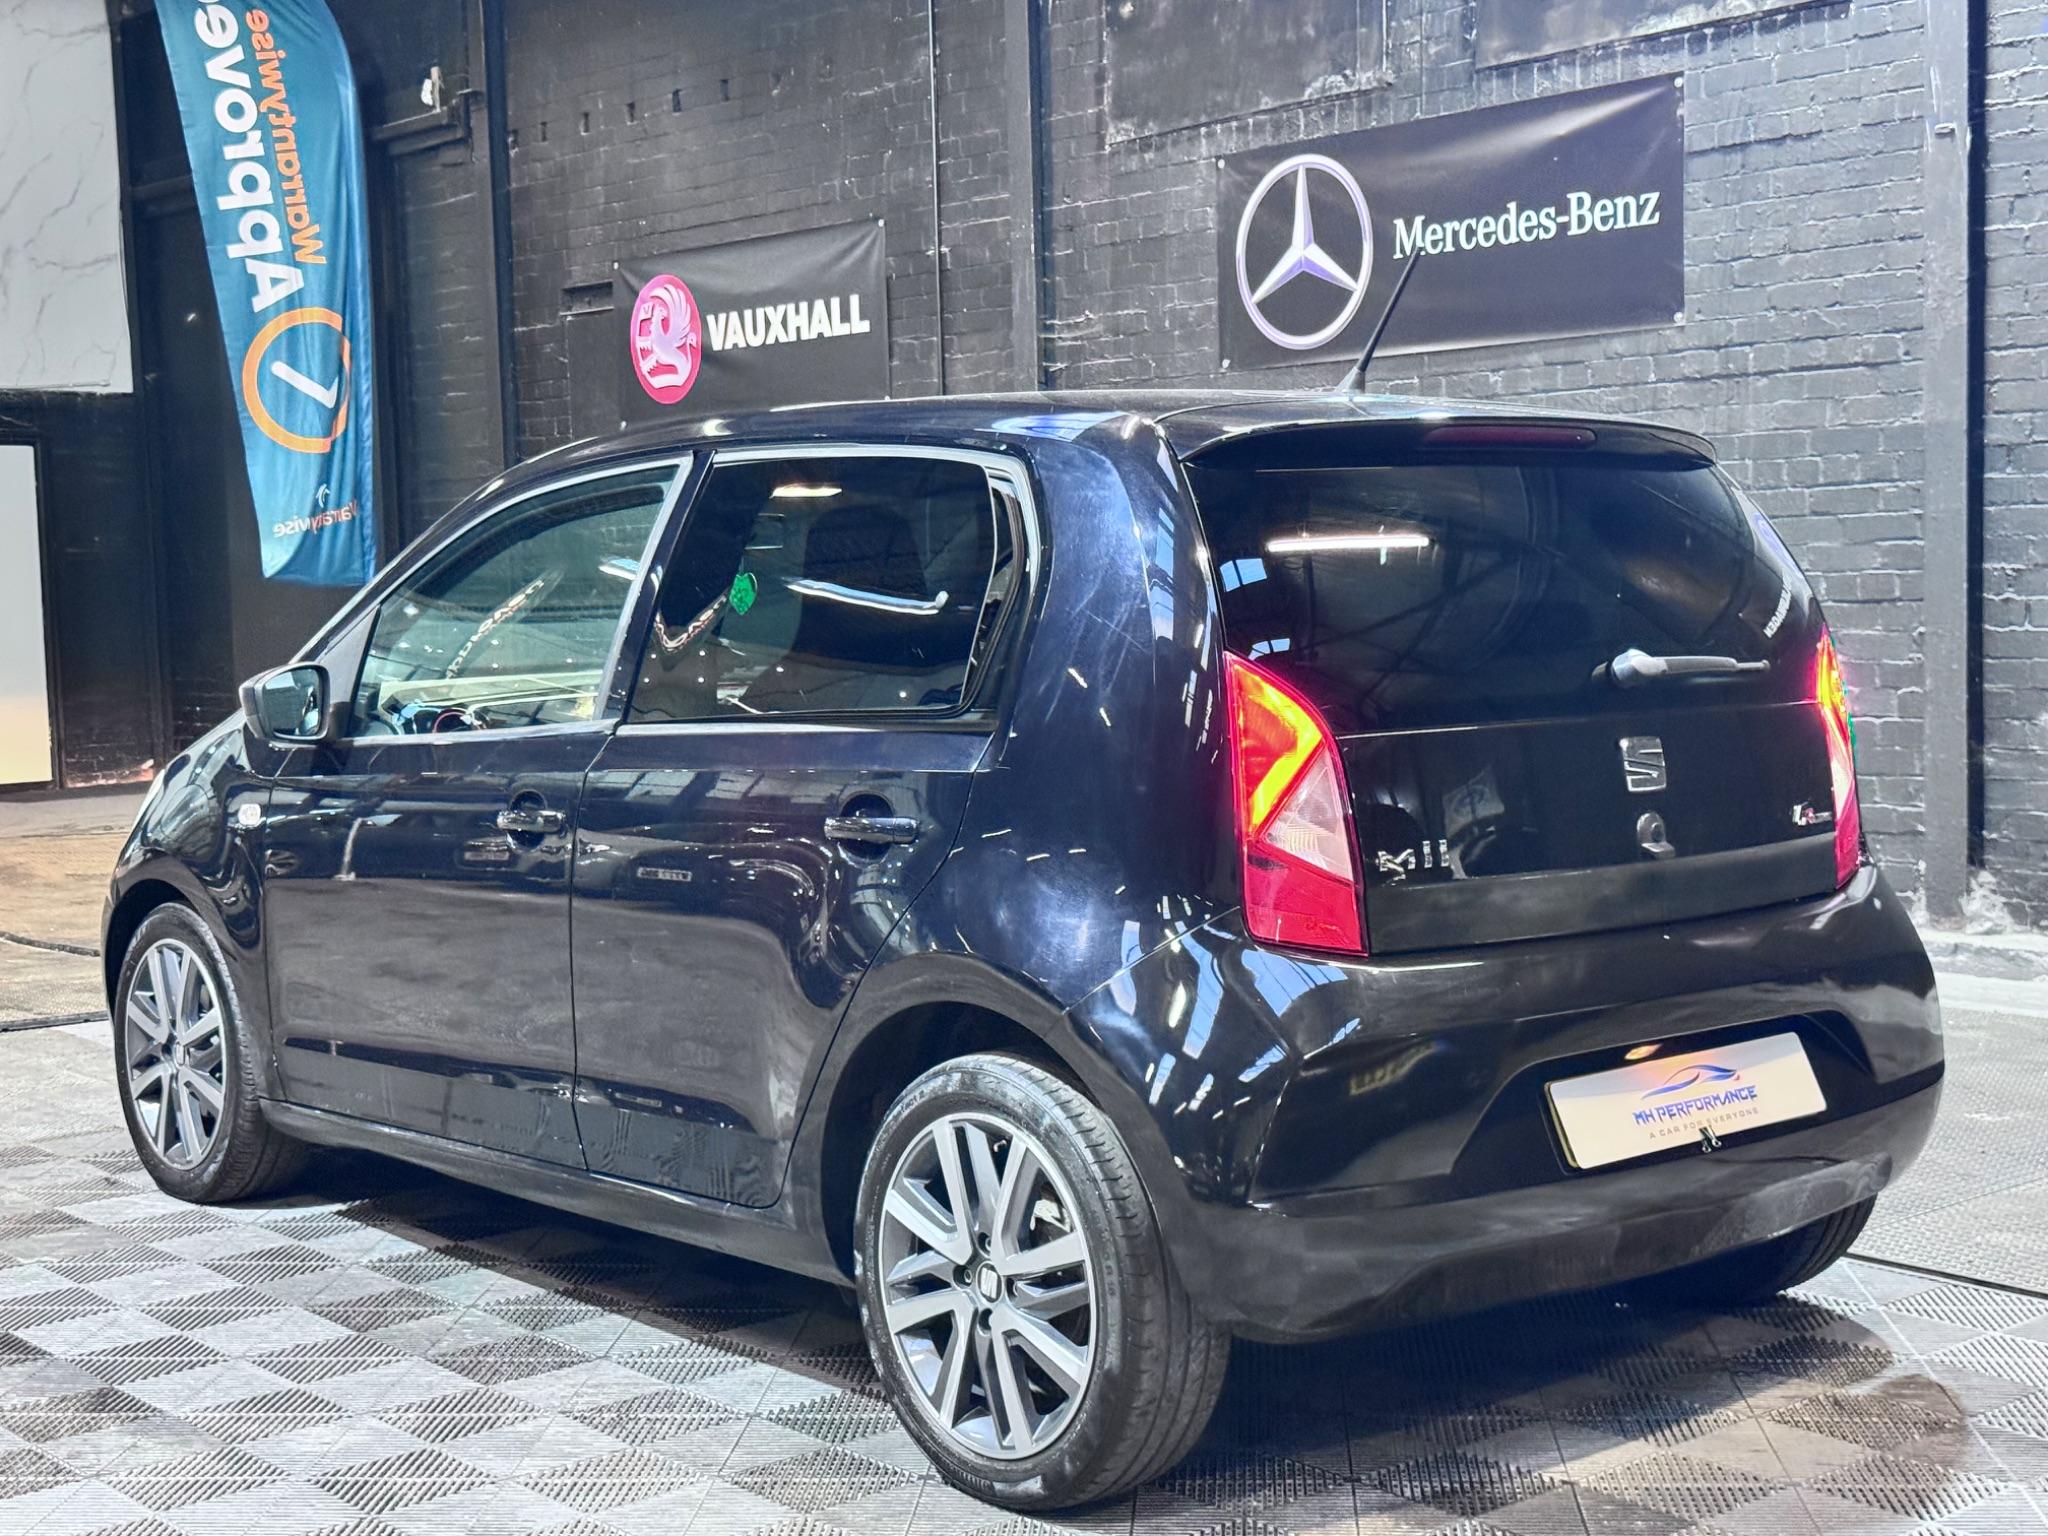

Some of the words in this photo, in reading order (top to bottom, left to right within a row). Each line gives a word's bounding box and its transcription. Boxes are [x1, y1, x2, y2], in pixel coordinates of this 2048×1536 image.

[1392, 191, 1661, 260] Mercedes-Benz
[706, 294, 871, 351] VAUXHALL
[1649, 1132, 1656, 1140] A
[1659, 1126, 1681, 1137] CAR
[1683, 1119, 1704, 1131] FOR
[1707, 1106, 1760, 1128] EVERYONE
[1655, 1085, 1758, 1123] PERFORMANCE
